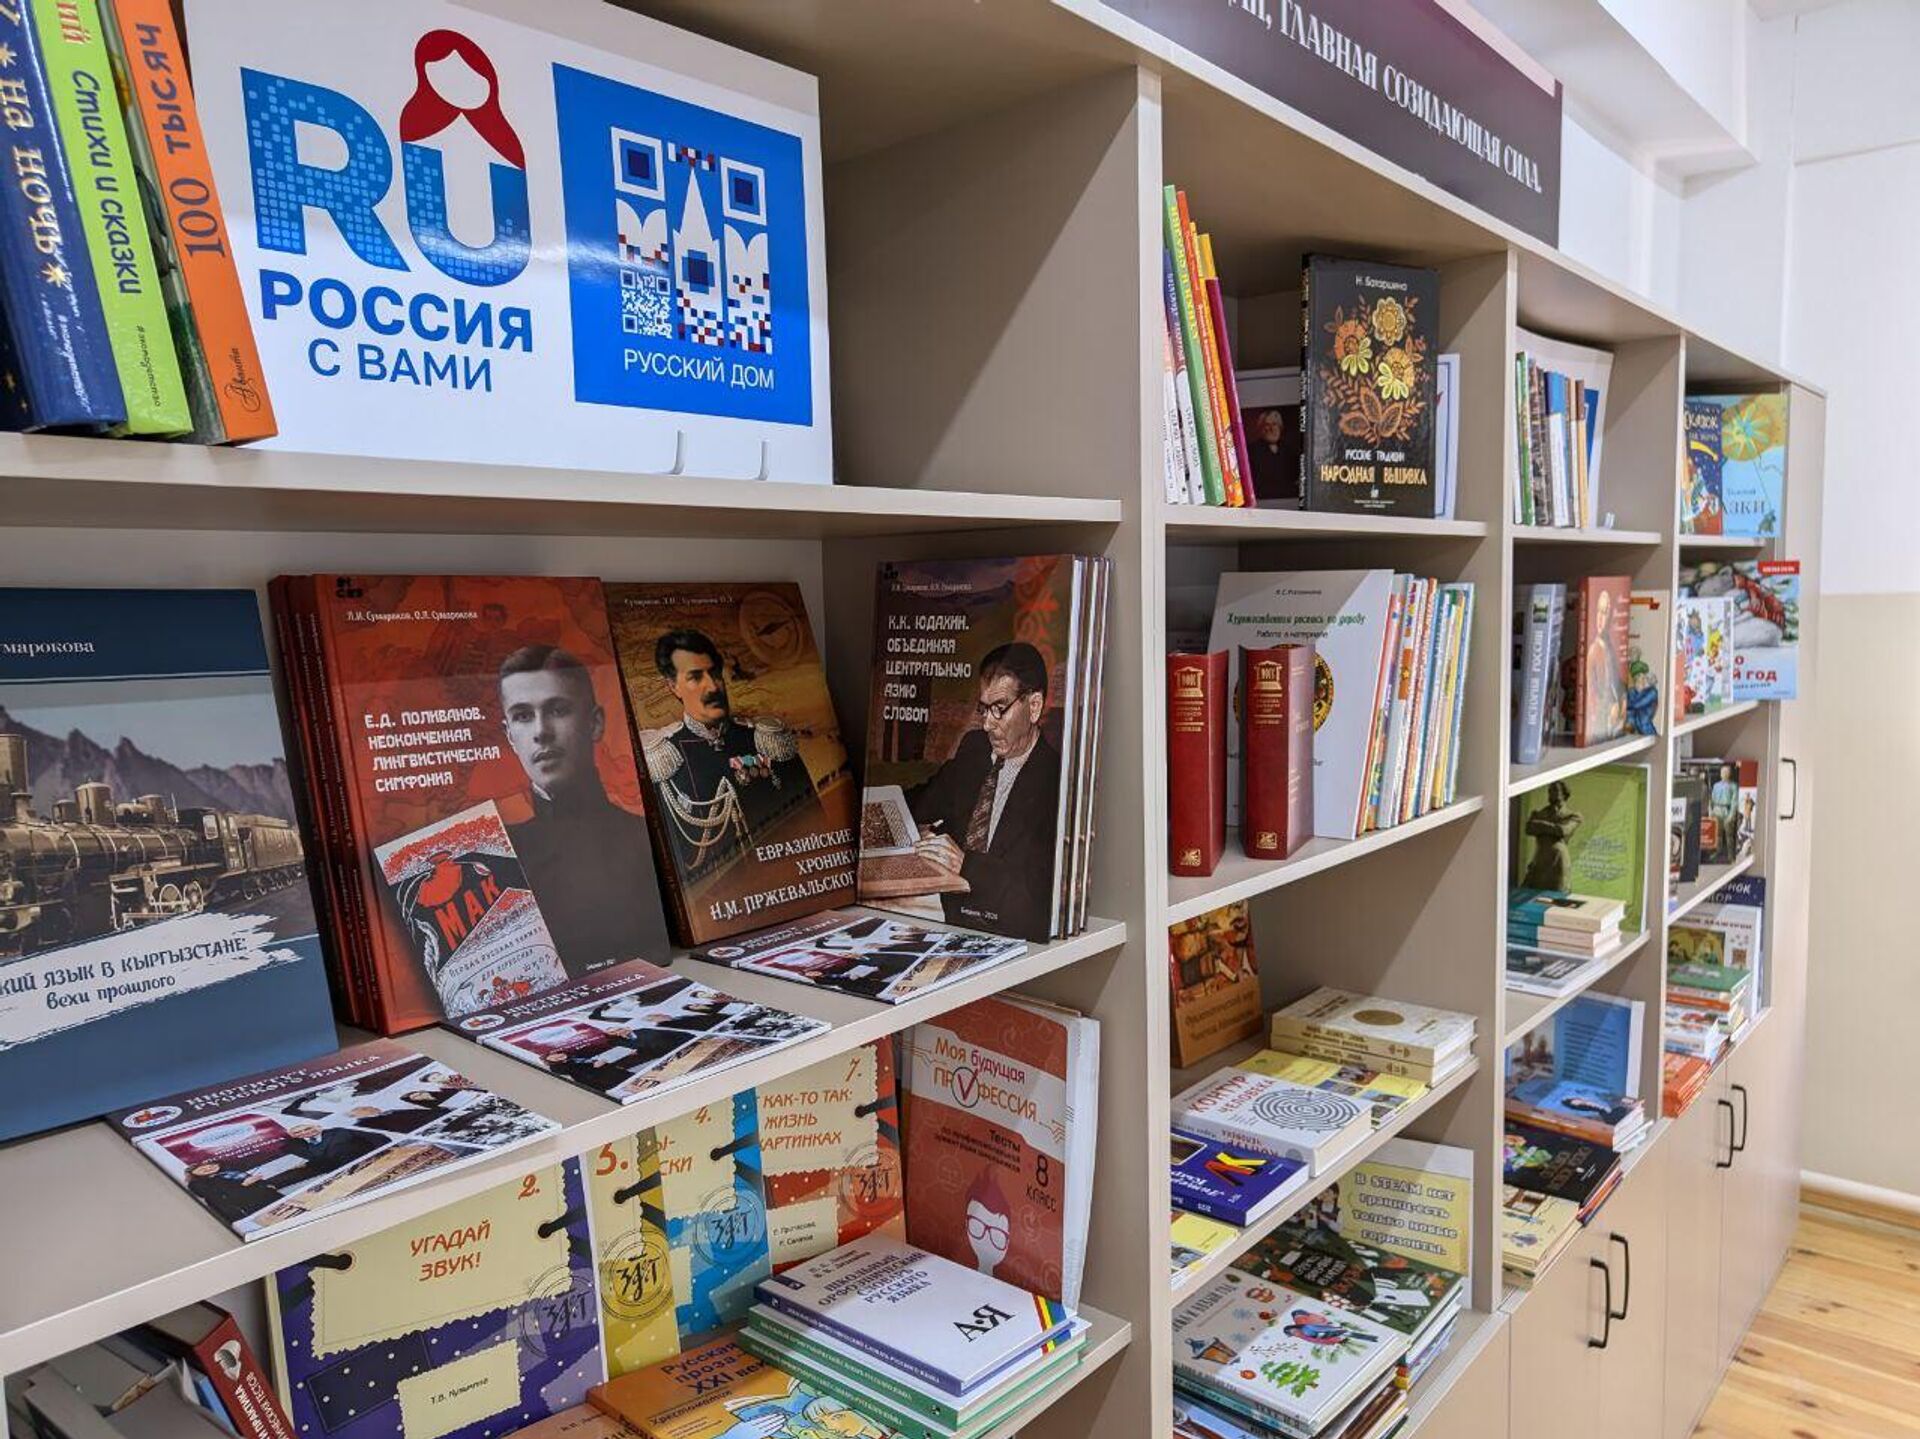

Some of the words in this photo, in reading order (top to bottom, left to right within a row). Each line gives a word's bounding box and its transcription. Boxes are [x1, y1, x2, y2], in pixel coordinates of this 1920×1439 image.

[1383, 64, 1501, 168] СОЗИДАЮЩАЯ
[72, 70, 114, 167] Стихи
[100, 199, 141, 296] сказки
[169, 178, 226, 259] 100
[259, 269, 533, 353] РОССИЯ
[309, 338, 340, 376] С
[357, 343, 493, 393] ВАМИ
[624, 347, 726, 382] РУССКИЙ
[730, 361, 775, 391] ДОМ
[1320, 465, 1375, 484] НАРОДНАЯ
[1383, 466, 1428, 485] ВЫШИВКА
[915, 613, 970, 632] ЮДАХИН.
[887, 636, 956, 655] ОБЪЕДИНЯЯ
[884, 659, 972, 680] ЦЕНТРАЛЬНУЮ
[884, 682, 918, 699] АЗИЮ
[364, 713, 396, 729] Е.Д.
[401, 705, 487, 727] ПОЛИВАНОВ.
[883, 704, 930, 724] СЛОВОМ
[368, 727, 472, 752] НЕОКОНЧЕННАЯ
[372, 746, 501, 772] ЛИНГВИСТИЧЕСКАЯ
[375, 771, 454, 794] СИМФОНИЯ
[756, 828, 854, 864] ЕВРАЗИЙСКИЕ
[434, 874, 504, 951] МАК
[44, 964, 95, 991] ЯЗЫК
[121, 938, 249, 975] КЫРГЫЗСТАНЕ:
[46, 989, 91, 1011] вехи
[95, 973, 178, 1004] прошлого
[936, 1036, 968, 1064] Моя
[971, 1050, 1026, 1085] будущая
[762, 1090, 821, 1108] КАК-ТО
[1188, 1074, 1248, 1114] КОНТУР
[764, 1113, 819, 1130] ЖИЗНЬ
[989, 1129, 1021, 1152] Тесты
[1036, 1154, 1049, 1187] 8
[518, 1173, 541, 1201] 2.
[1370, 1174, 1423, 1196] STEAM
[411, 1219, 492, 1257] УГАДАЙ
[418, 1253, 482, 1283] ЗВУК!
[660, 1342, 739, 1377] Русская
[673, 1356, 737, 1384] проза
[738, 1359, 769, 1379] век
